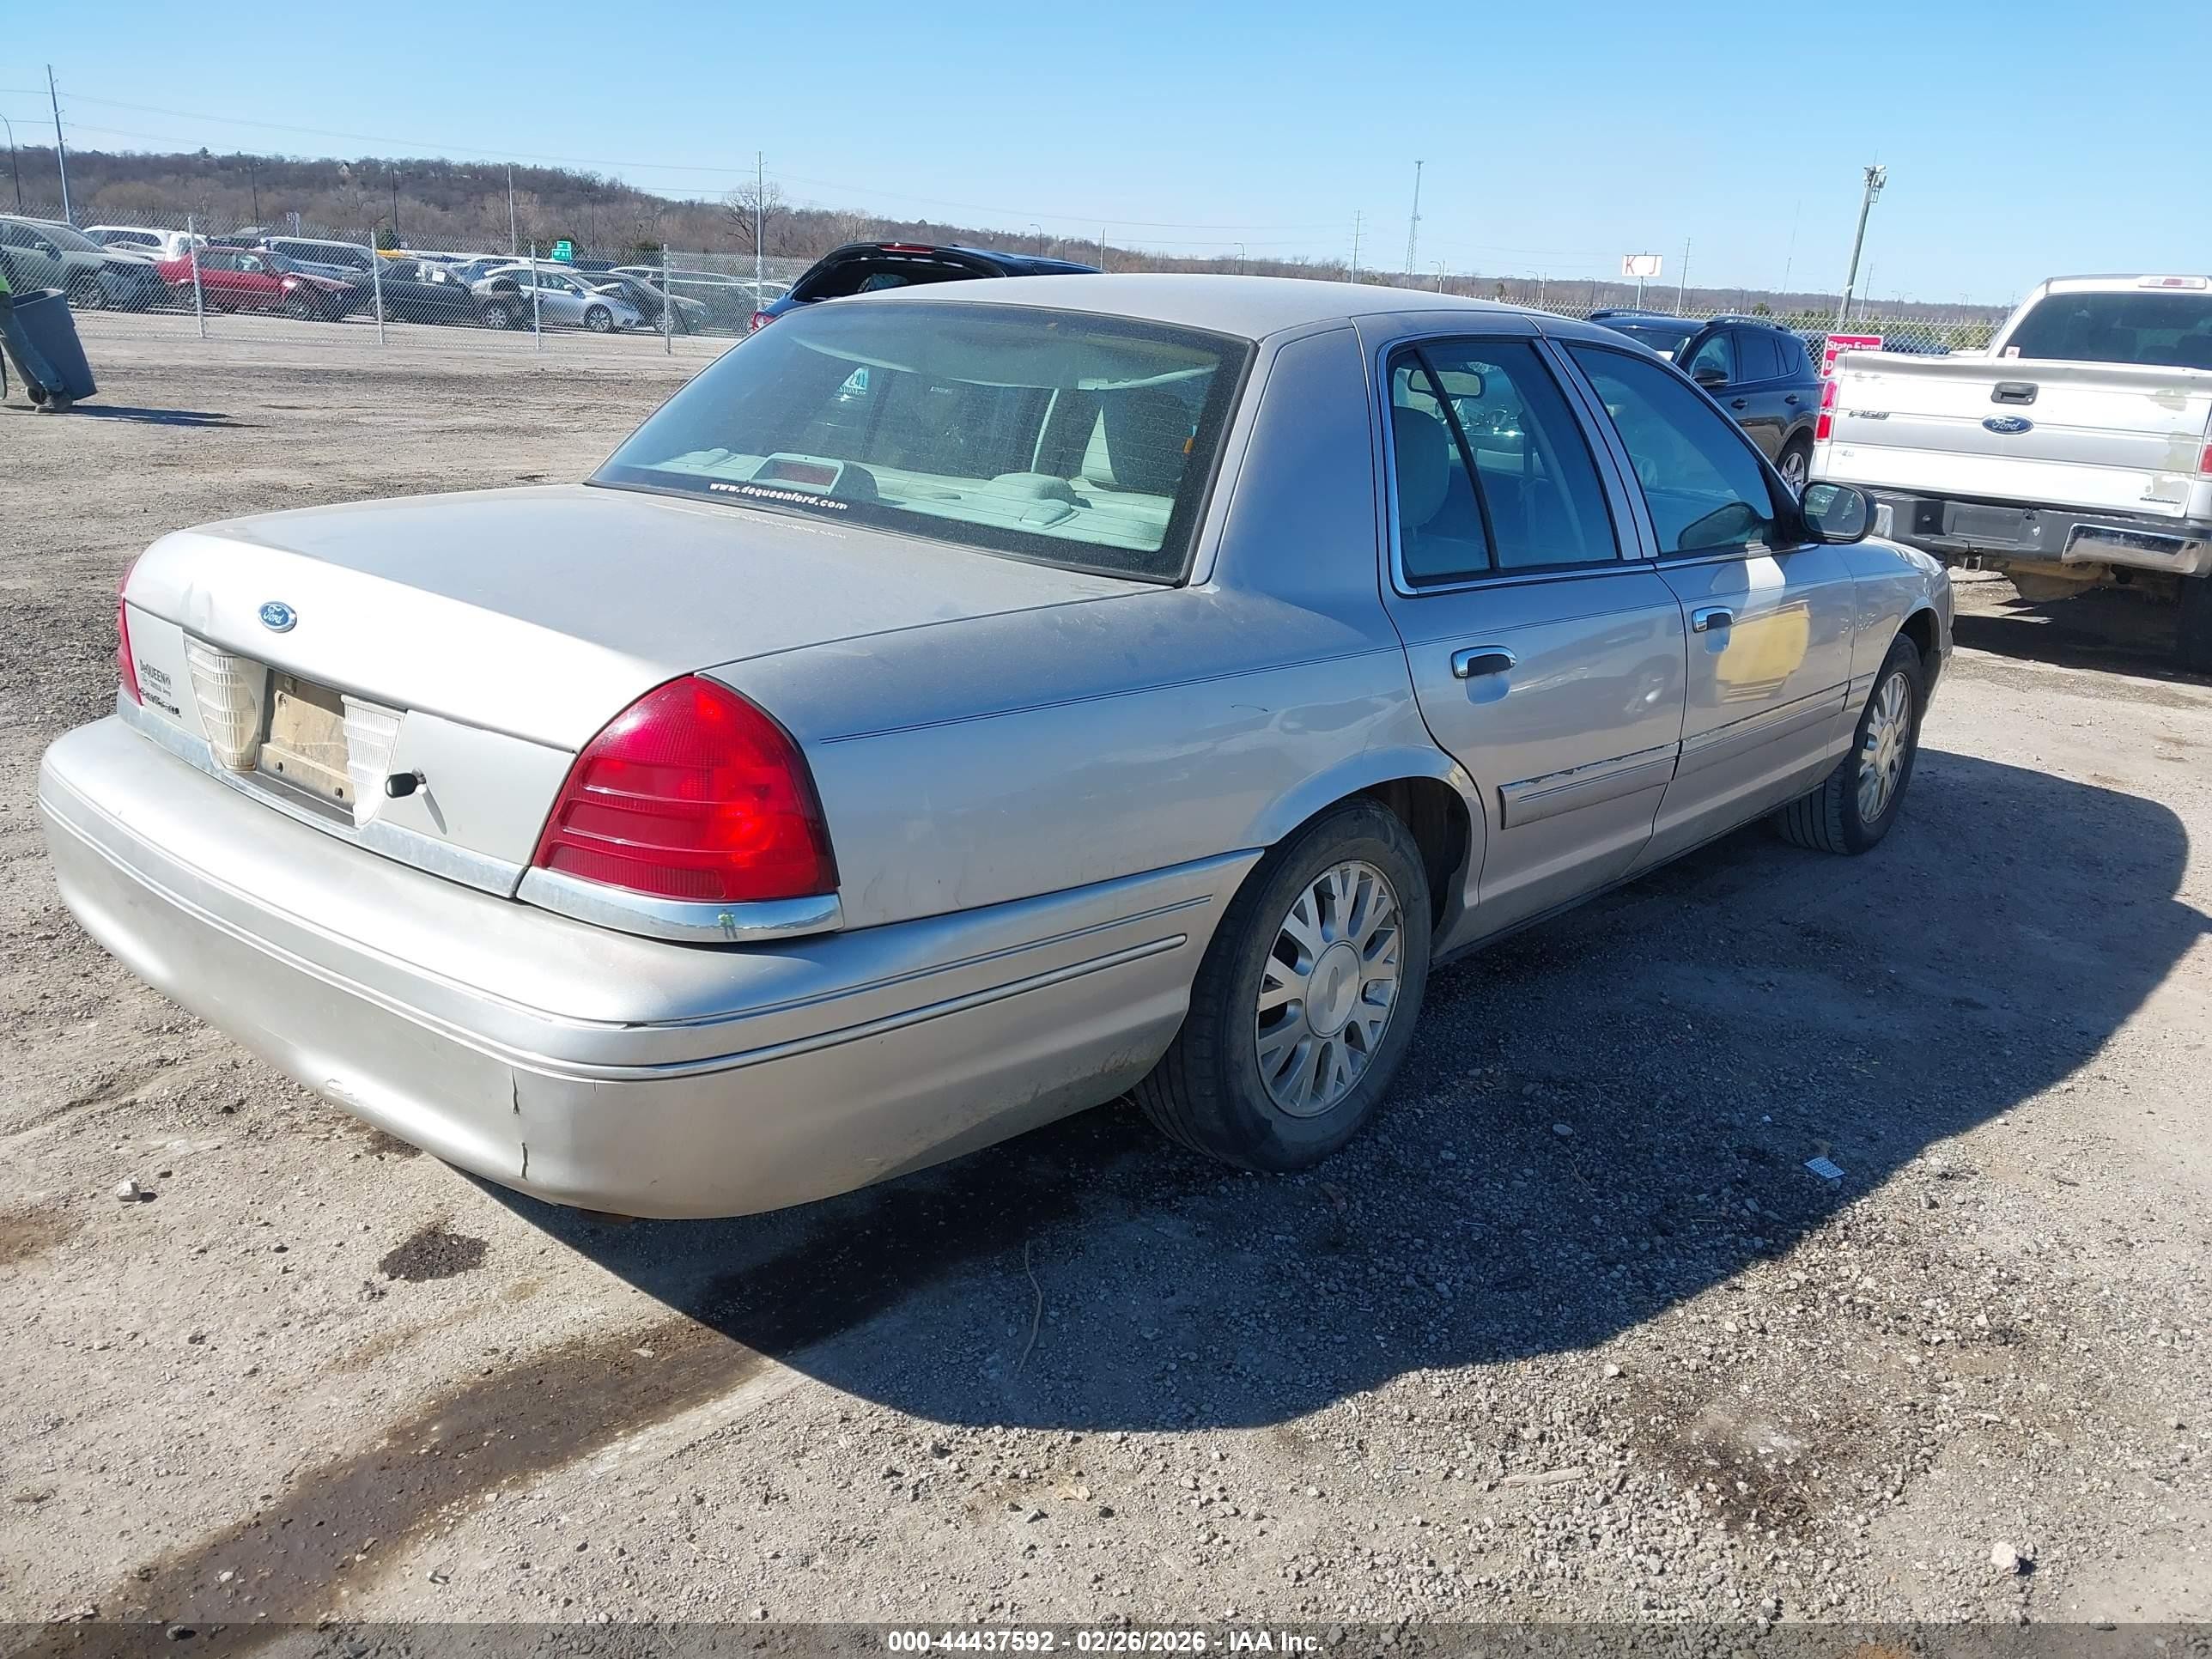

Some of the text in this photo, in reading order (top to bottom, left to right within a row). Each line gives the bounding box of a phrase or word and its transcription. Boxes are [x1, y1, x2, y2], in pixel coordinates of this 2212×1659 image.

[1626, 255, 1657, 275] K J
[709, 482, 848, 510] www.dequeenford.com
[263, 605, 285, 624] Ford
